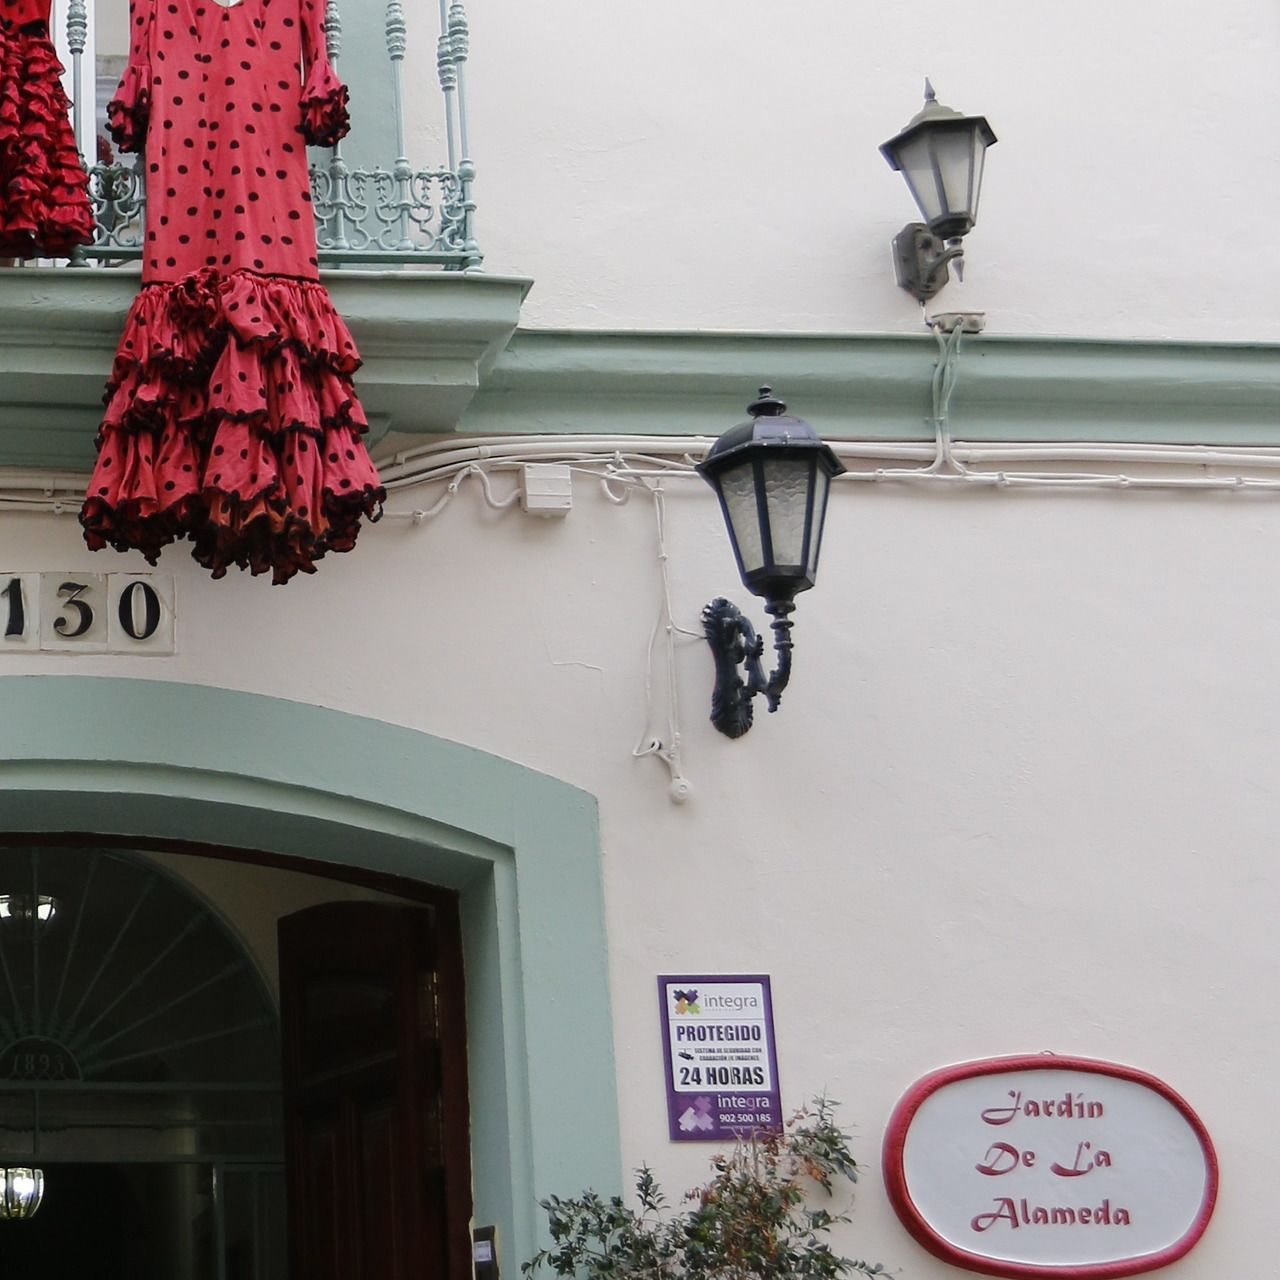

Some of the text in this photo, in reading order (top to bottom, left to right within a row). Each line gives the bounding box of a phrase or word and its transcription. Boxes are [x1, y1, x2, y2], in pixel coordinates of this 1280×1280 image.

[0, 577, 161, 640] 130
[704, 994, 758, 1011] integra
[676, 1024, 761, 1041] PROTEGIDO
[680, 1066, 764, 1085] 24 HORAS
[717, 1094, 770, 1111] integra
[980, 1089, 1104, 1126] Jardín
[719, 1113, 736, 1122] 902
[737, 1113, 754, 1122] 500
[974, 1140, 1112, 1177] De La
[970, 1197, 1131, 1233] Alameda
